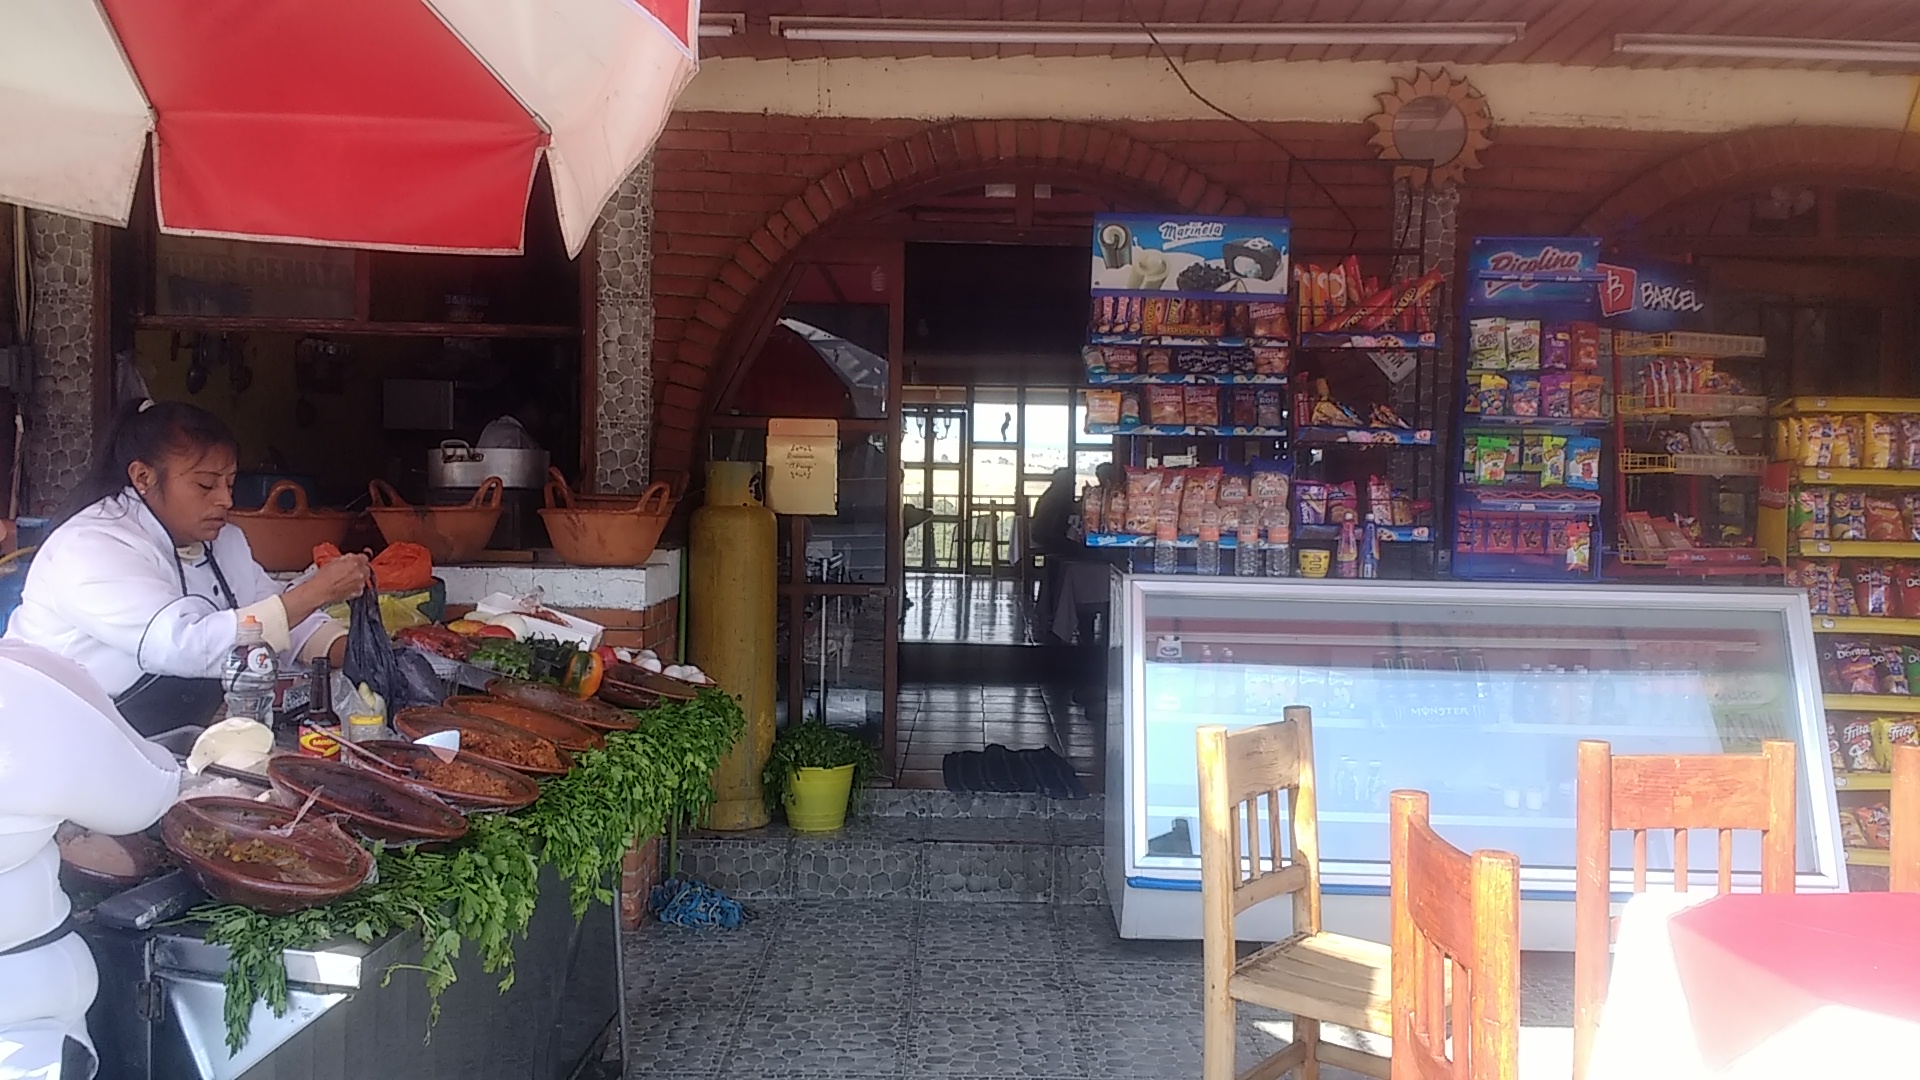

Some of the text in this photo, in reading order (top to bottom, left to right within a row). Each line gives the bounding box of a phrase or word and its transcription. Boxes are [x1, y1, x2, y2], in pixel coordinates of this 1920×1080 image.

[1160, 222, 1222, 240] Marinela
[1606, 270, 1625, 309] B
[1640, 282, 1704, 312] BARCEL
[1411, 707, 1469, 716] MONSTER
